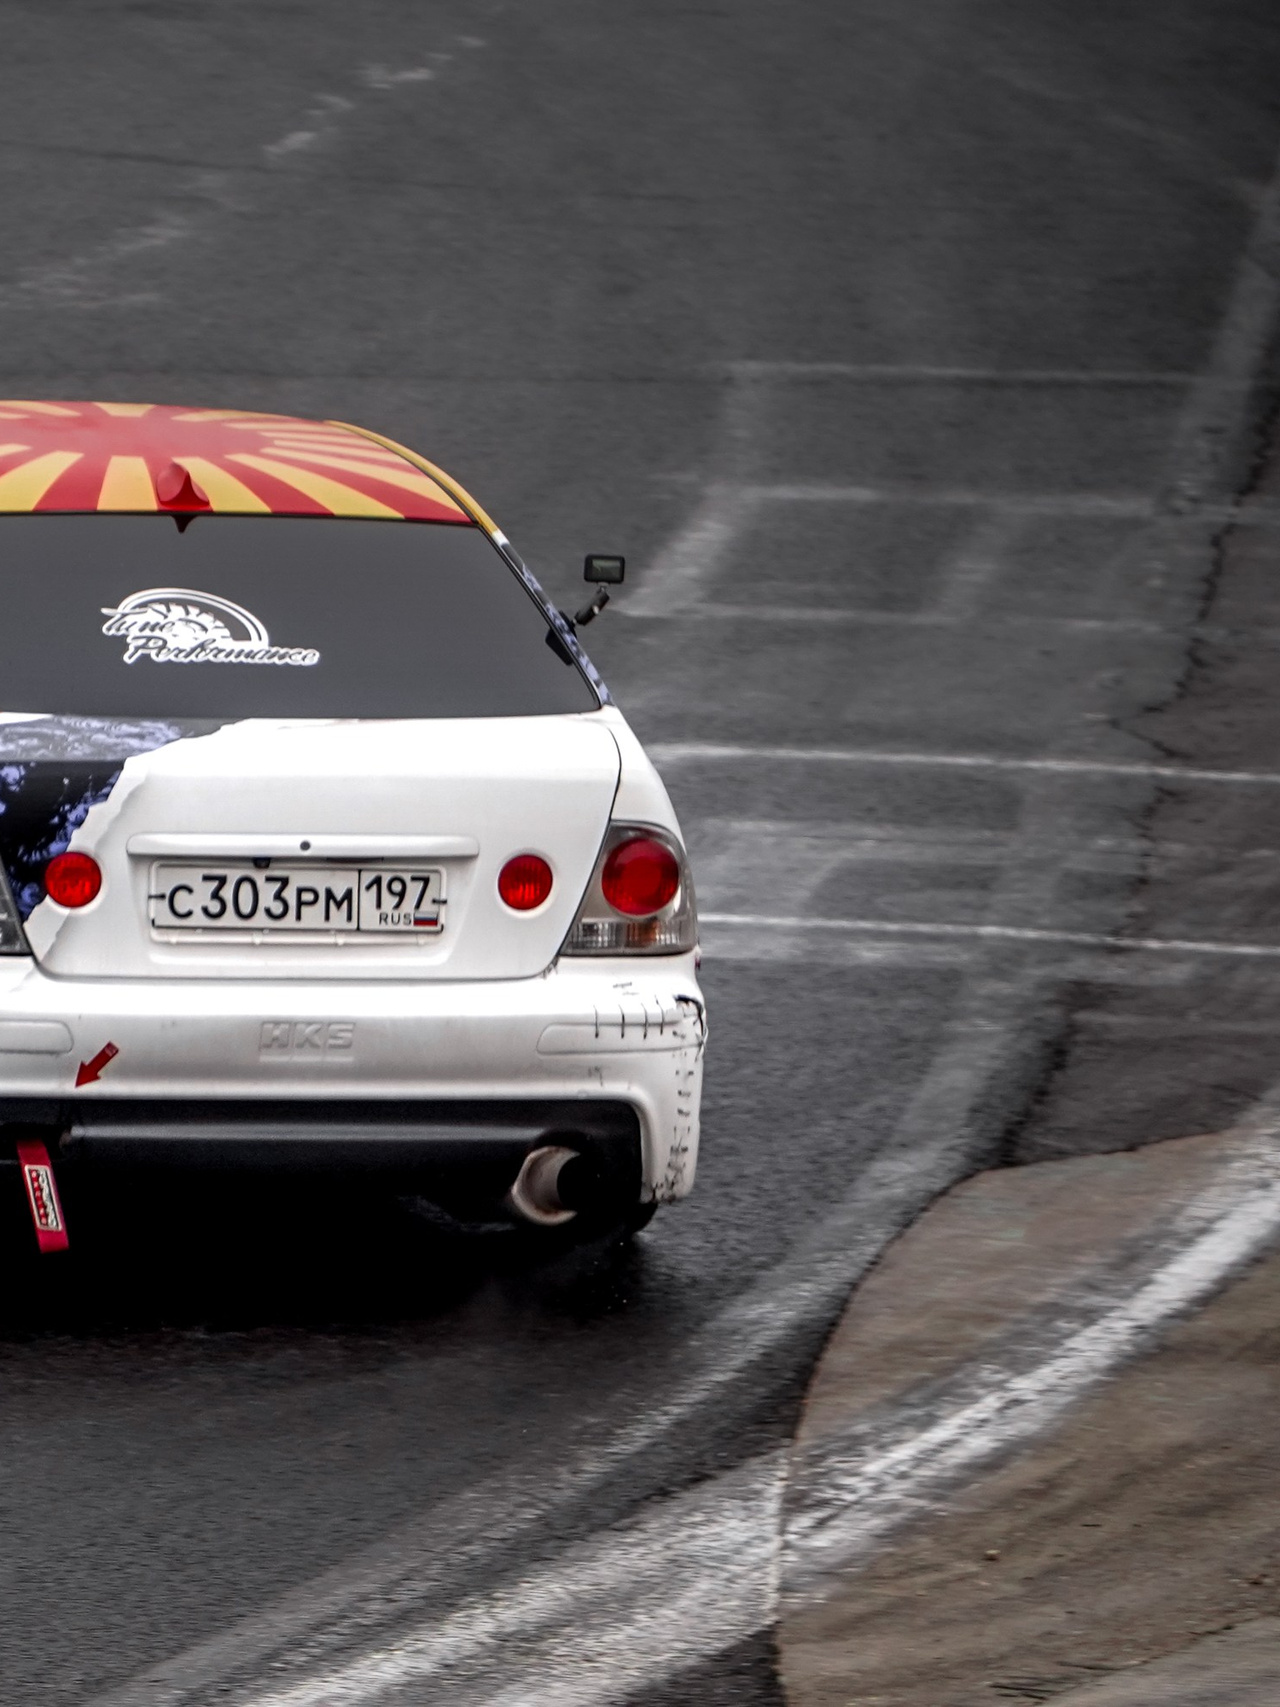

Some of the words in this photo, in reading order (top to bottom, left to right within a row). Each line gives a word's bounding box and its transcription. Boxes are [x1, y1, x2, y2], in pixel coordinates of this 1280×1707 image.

[124, 634, 320, 665] Performance
[167, 874, 354, 922] C303PM
[364, 875, 430, 910] 197
[379, 912, 412, 926] RUS
[260, 1020, 355, 1050] HKS
